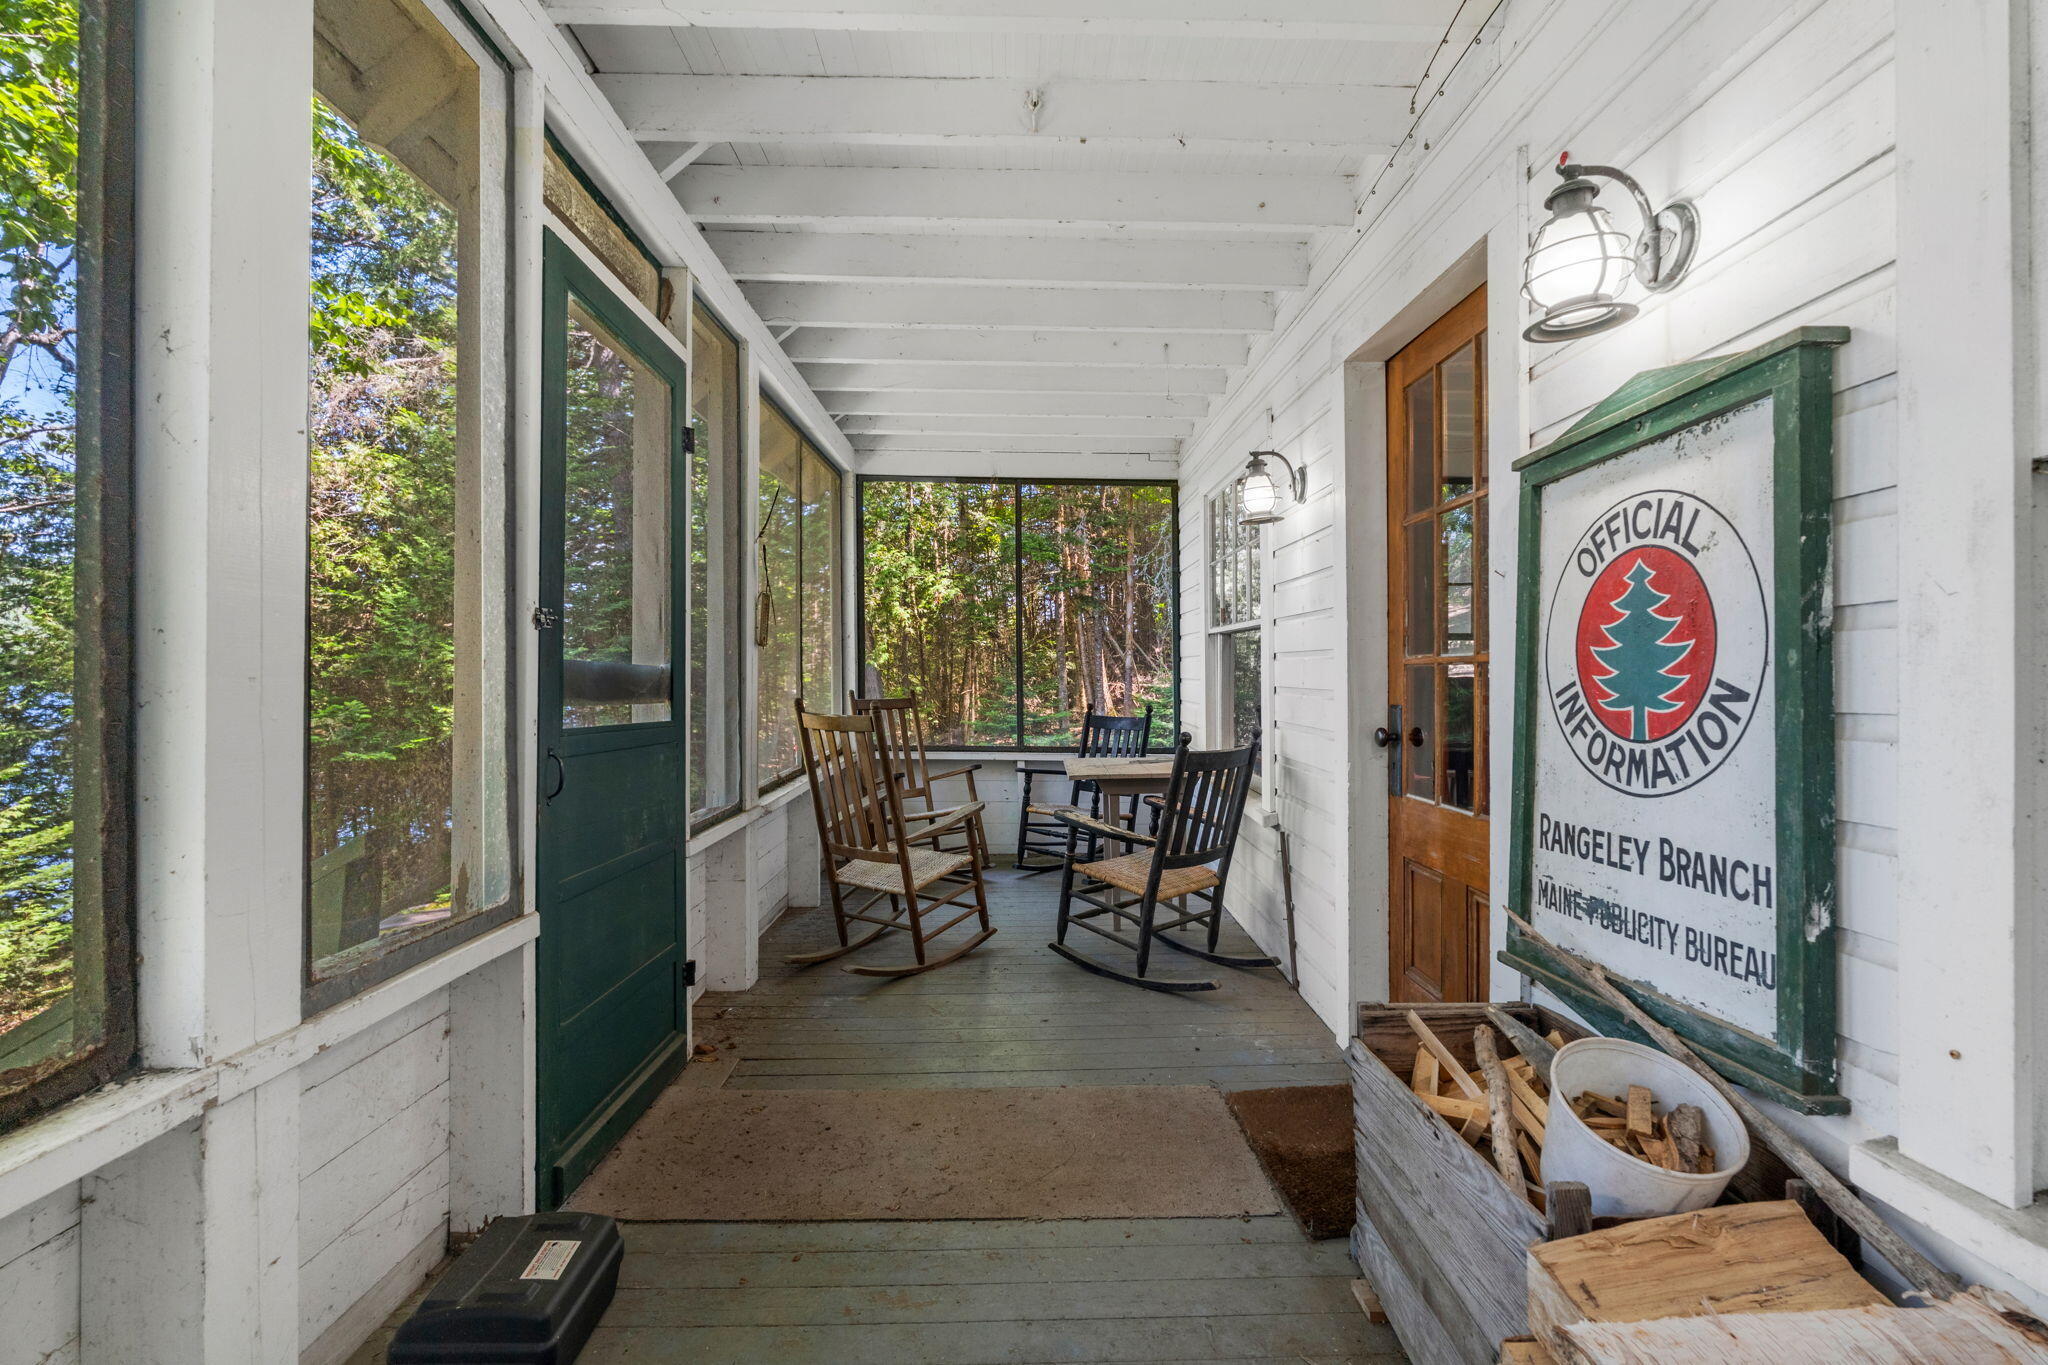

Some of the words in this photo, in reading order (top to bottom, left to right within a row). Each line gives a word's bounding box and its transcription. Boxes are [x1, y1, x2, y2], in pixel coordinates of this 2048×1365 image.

[1576, 498, 1702, 578] OFFICIAL
[1555, 677, 1751, 789] INFORMATION
[1539, 812, 1650, 876] RANGELEY
[1659, 837, 1773, 909] BRANCH
[1537, 878, 1583, 921] MAINE
[1685, 926, 1776, 991] BUREAU
